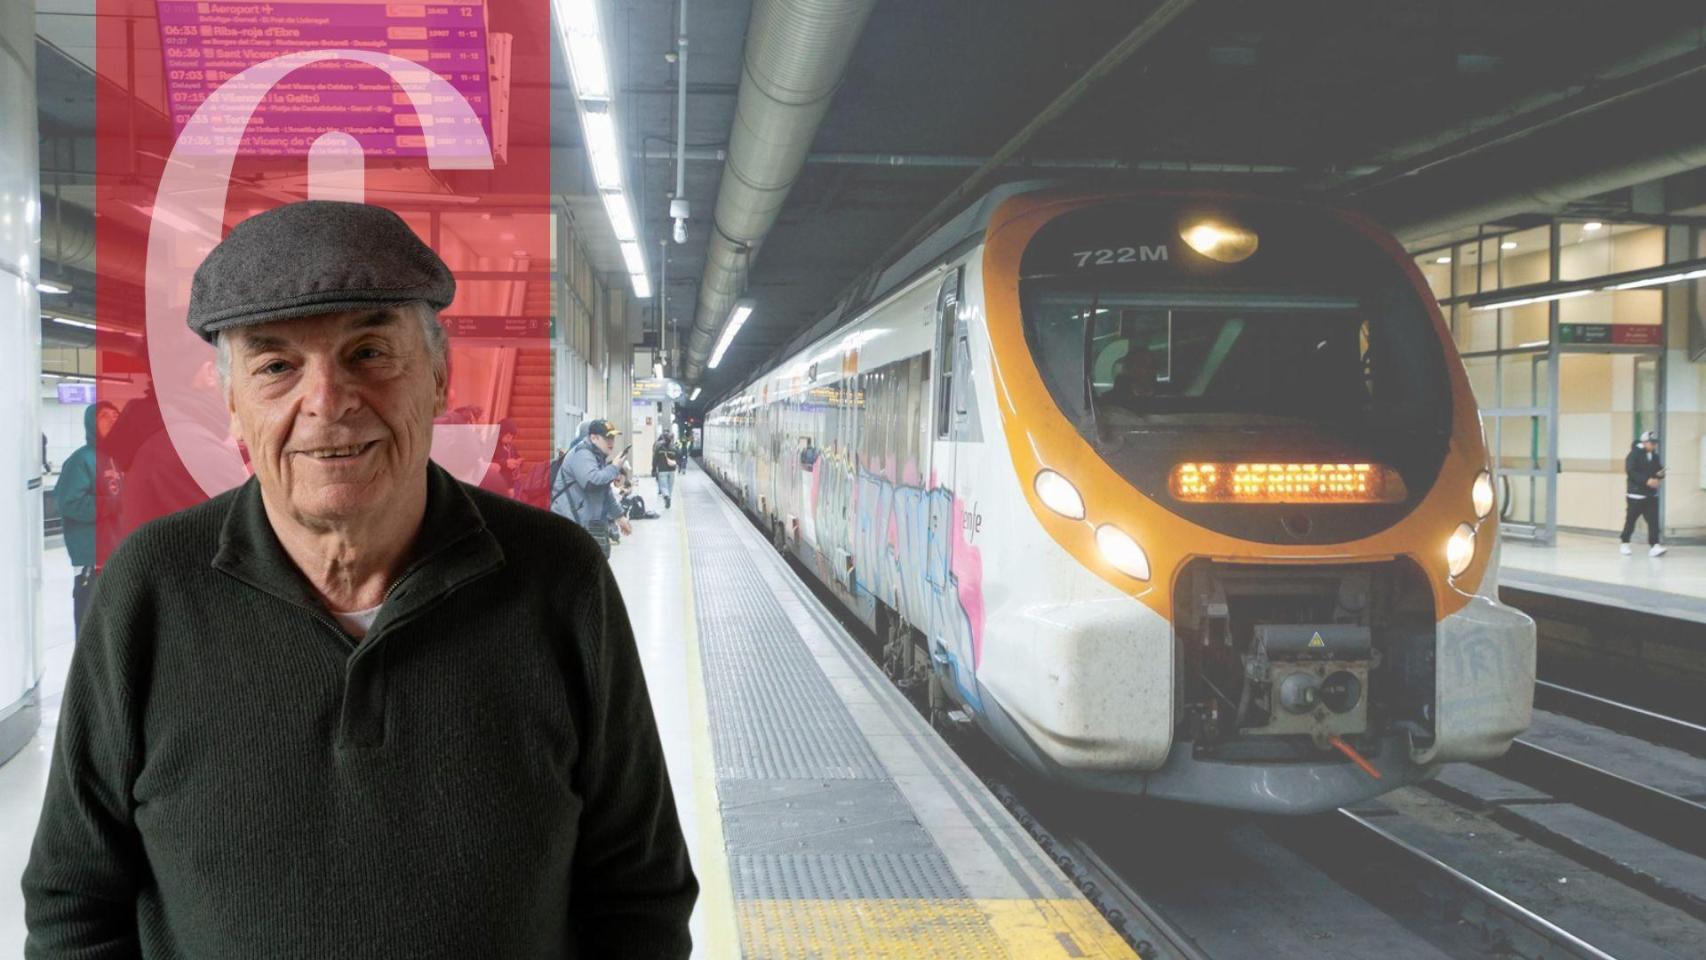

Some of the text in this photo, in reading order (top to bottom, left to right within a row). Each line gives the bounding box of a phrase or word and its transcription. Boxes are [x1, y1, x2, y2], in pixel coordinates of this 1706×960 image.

[211, 4, 260, 15] Aeroport
[460, 7, 473, 17] 12
[164, 25, 198, 36] 06:33
[214, 26, 264, 38] Riba-roja
[1073, 245, 1169, 268] 722M
[961, 501, 982, 544] enfe
